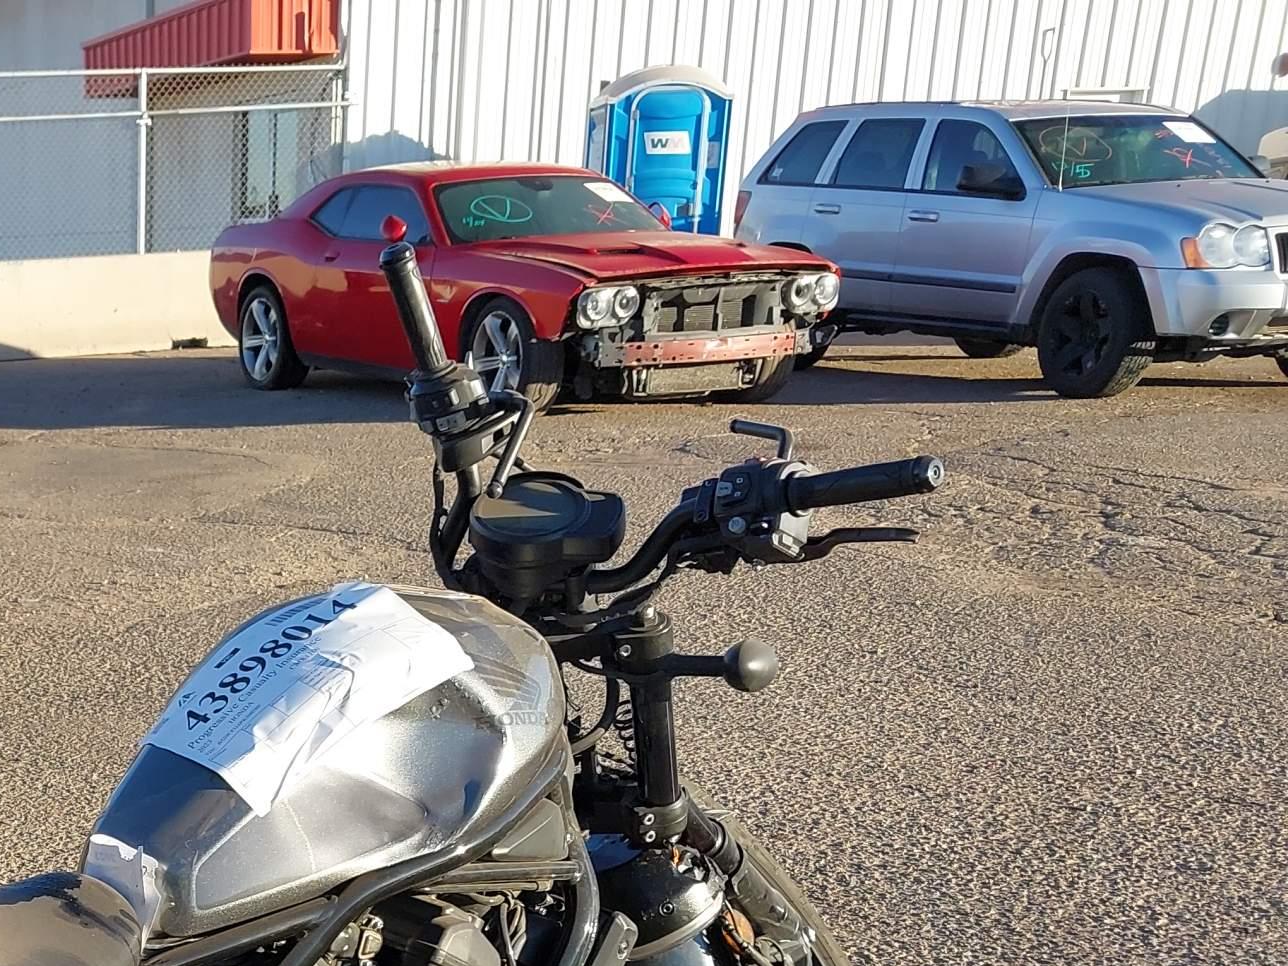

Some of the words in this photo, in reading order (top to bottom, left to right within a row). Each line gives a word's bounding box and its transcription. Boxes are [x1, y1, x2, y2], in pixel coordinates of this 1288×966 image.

[185, 600, 358, 731] 43898014
[187, 701, 239, 750] Progressive
[239, 669, 278, 703] Casualty
[275, 636, 322, 670] Insurance
[228, 698, 254, 726] HONDA
[492, 710, 549, 727] ONDA
